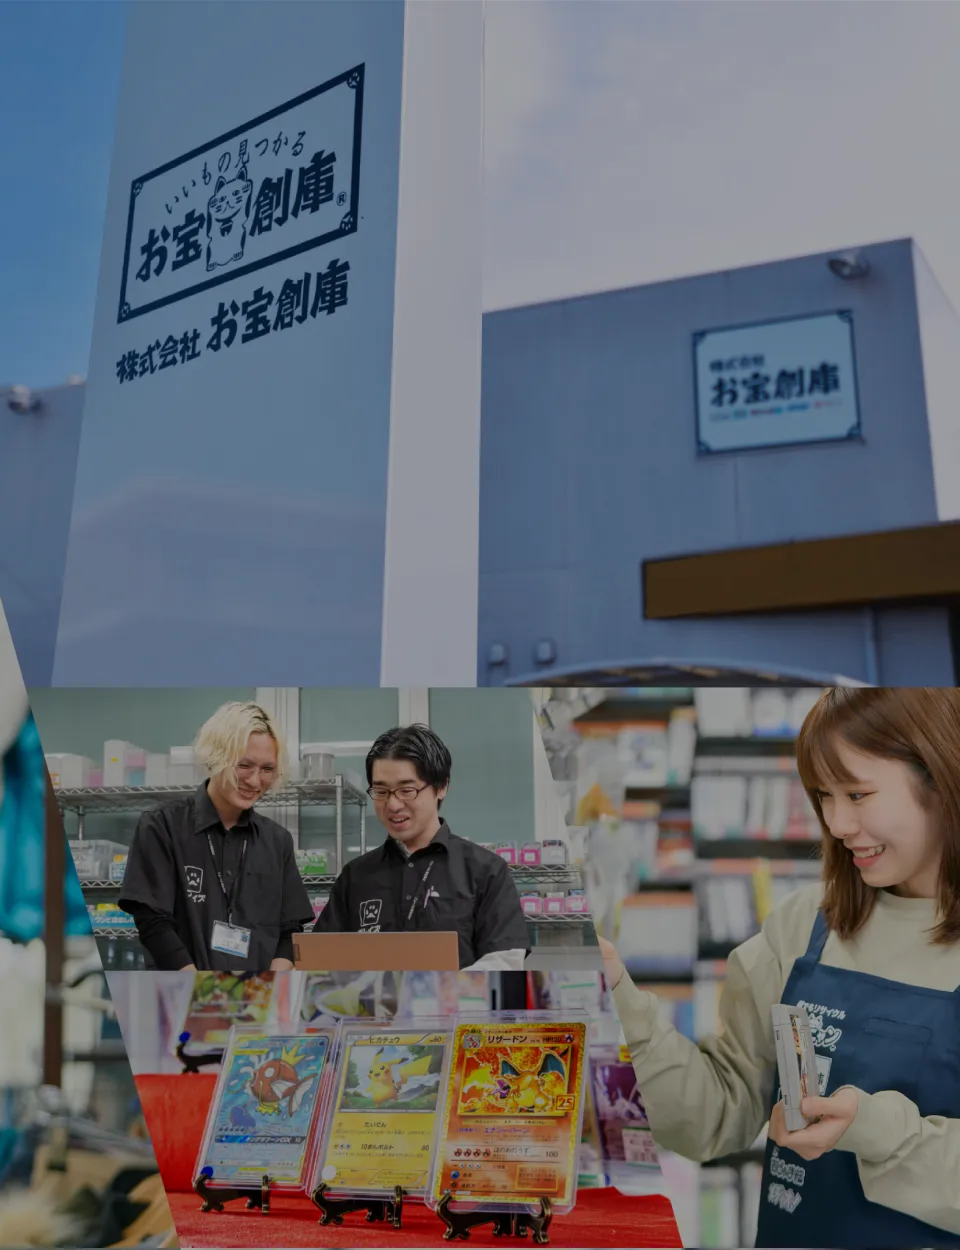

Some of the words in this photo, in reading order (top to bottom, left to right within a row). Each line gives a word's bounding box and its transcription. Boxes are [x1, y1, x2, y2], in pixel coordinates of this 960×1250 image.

[136, 149, 337, 282] お宝創庫
[164, 130, 307, 213] いいもの見つかる
[116, 329, 201, 384] 株式会社
[206, 258, 350, 352] お宝創庫
[487, 1035, 528, 1043] リザードン
